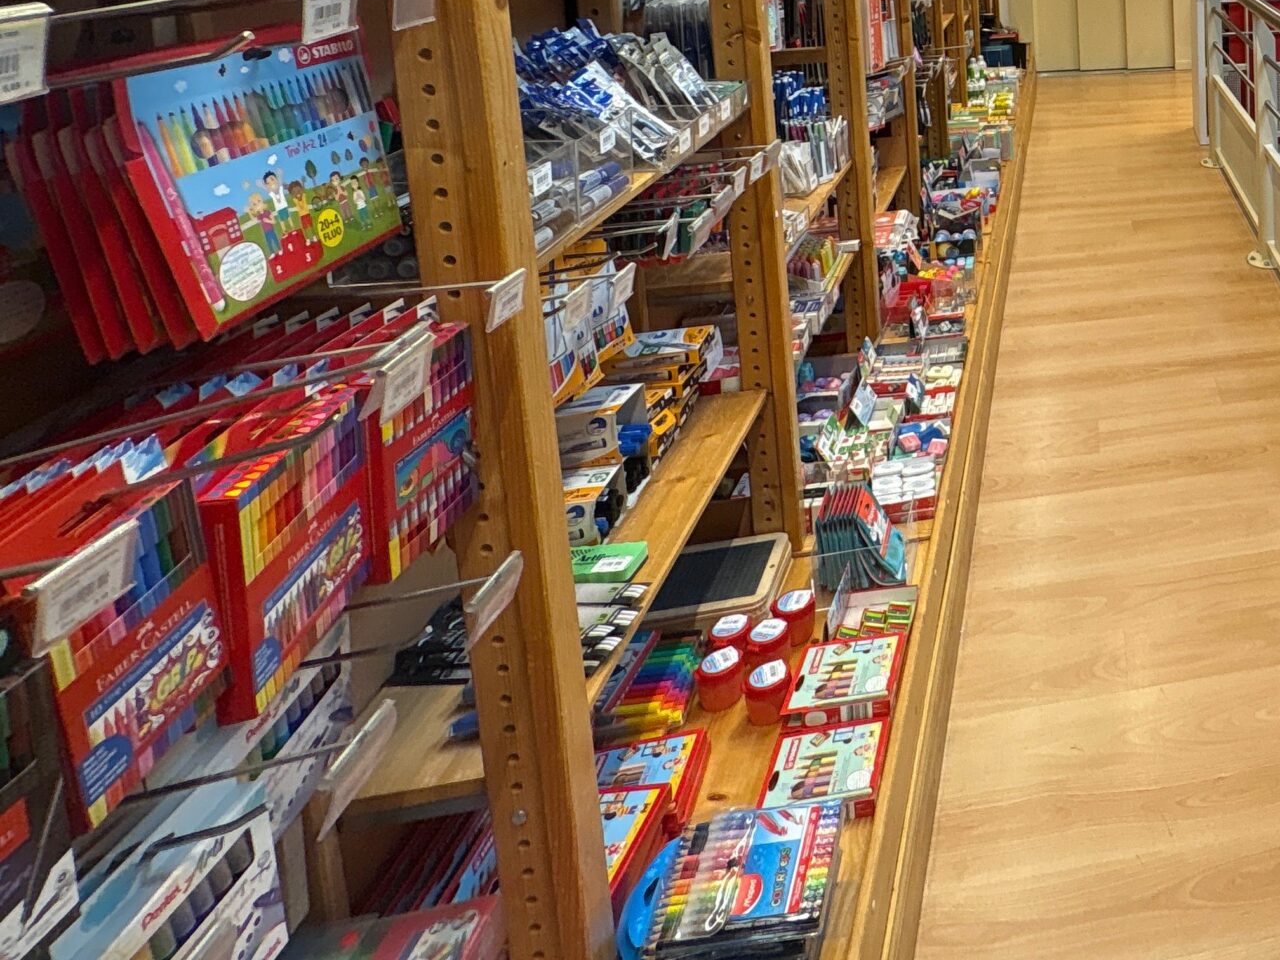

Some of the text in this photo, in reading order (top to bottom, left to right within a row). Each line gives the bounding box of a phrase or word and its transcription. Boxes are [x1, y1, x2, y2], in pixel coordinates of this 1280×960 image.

[312, 39, 354, 59] STABILO
[318, 213, 341, 232] 20+4
[322, 227, 342, 242] FLUO
